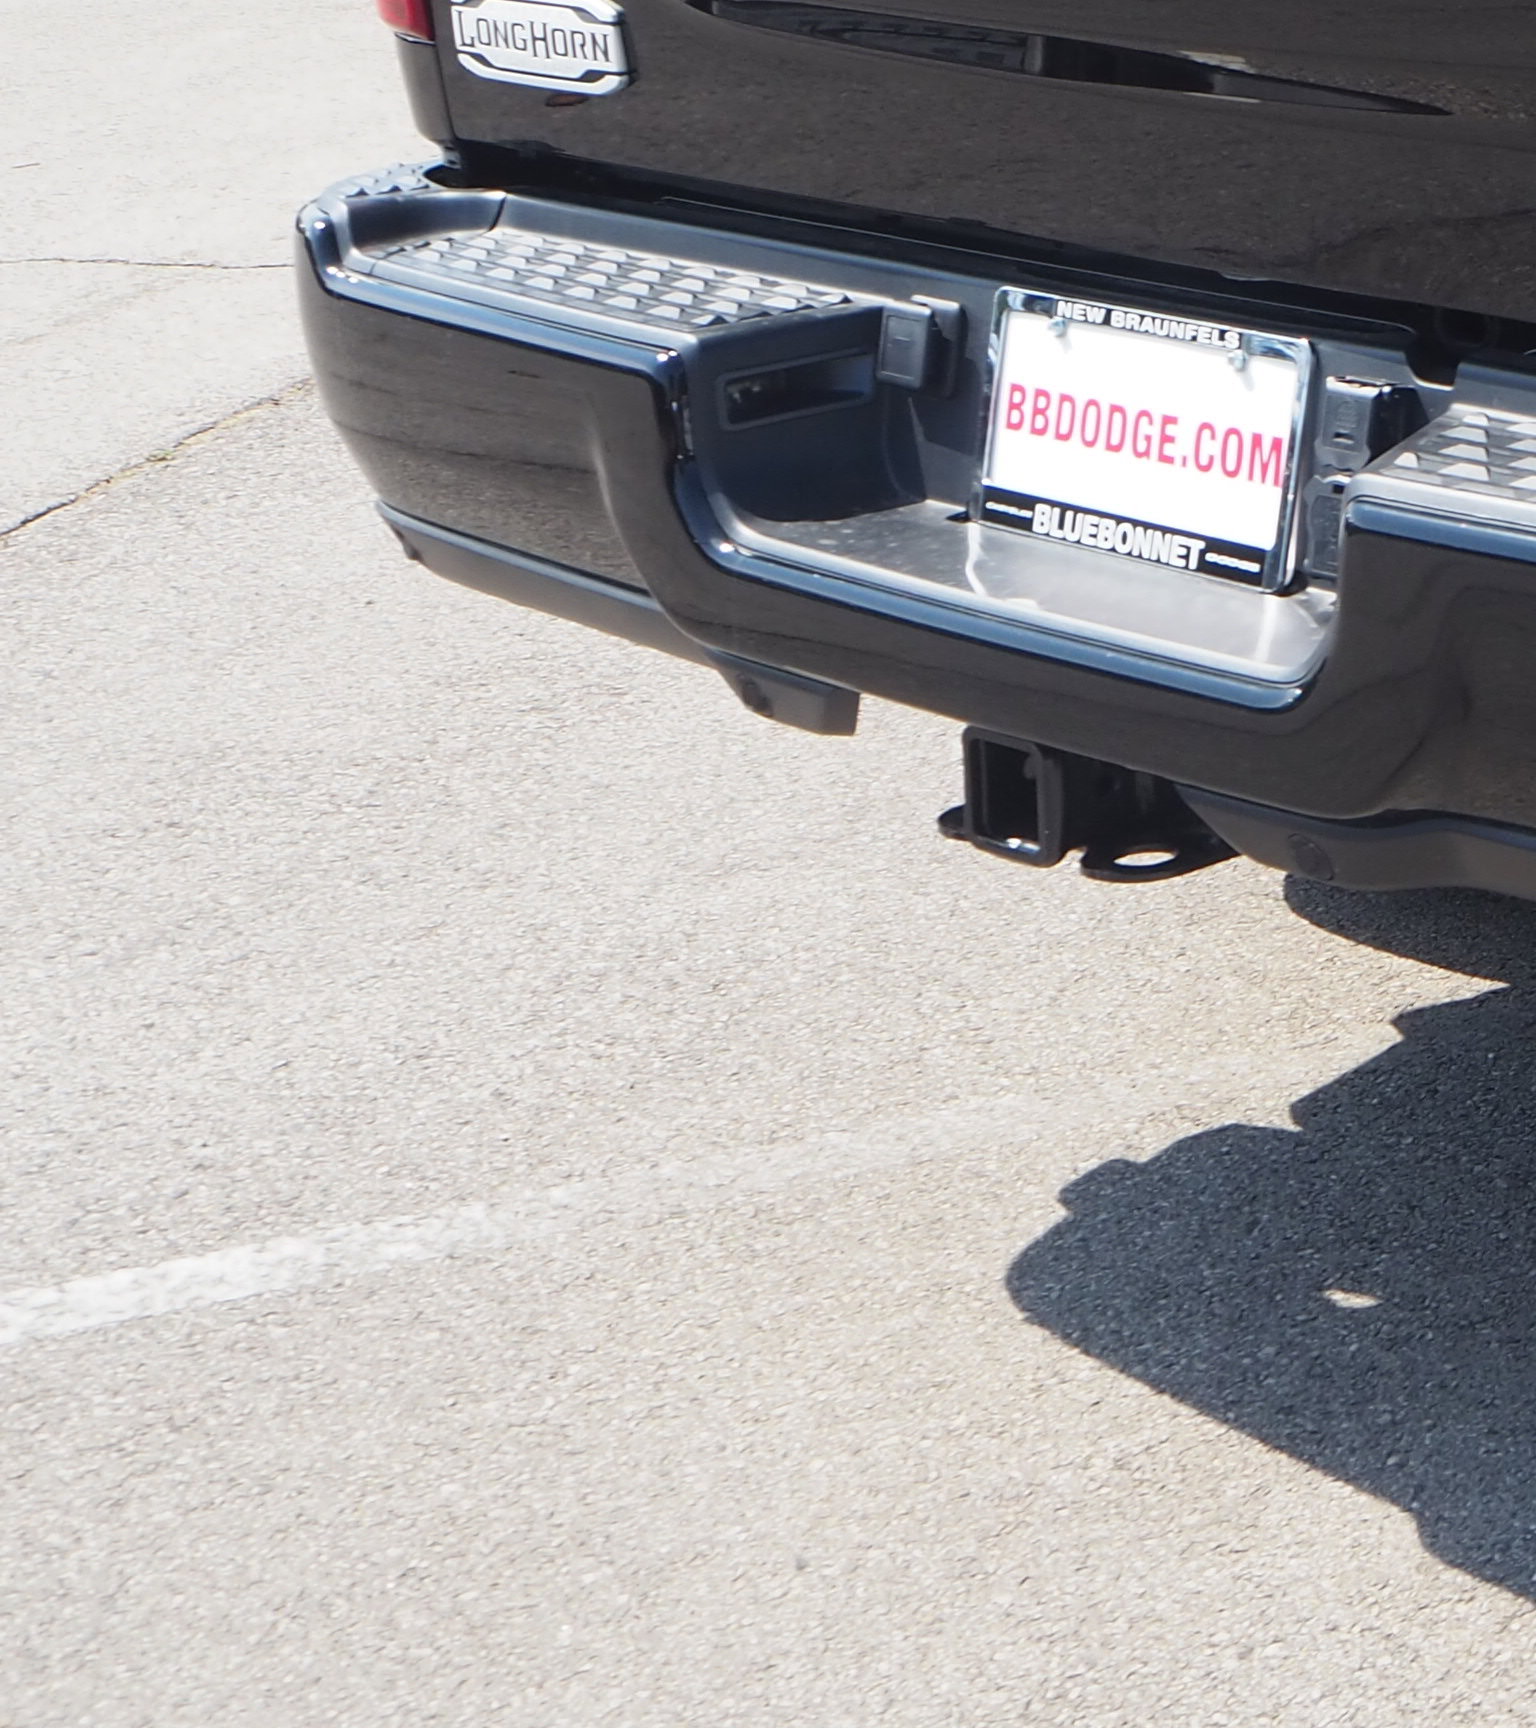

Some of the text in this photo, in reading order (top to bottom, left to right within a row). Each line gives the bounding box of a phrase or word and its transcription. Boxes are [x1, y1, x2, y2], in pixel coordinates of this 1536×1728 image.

[455, 10, 612, 64] LONGHORN
[1056, 300, 1242, 351] NEW BRAUNFELS
[1005, 382, 1288, 488] BBDODGE.COM
[1031, 502, 1206, 572] BLUEBONNET
